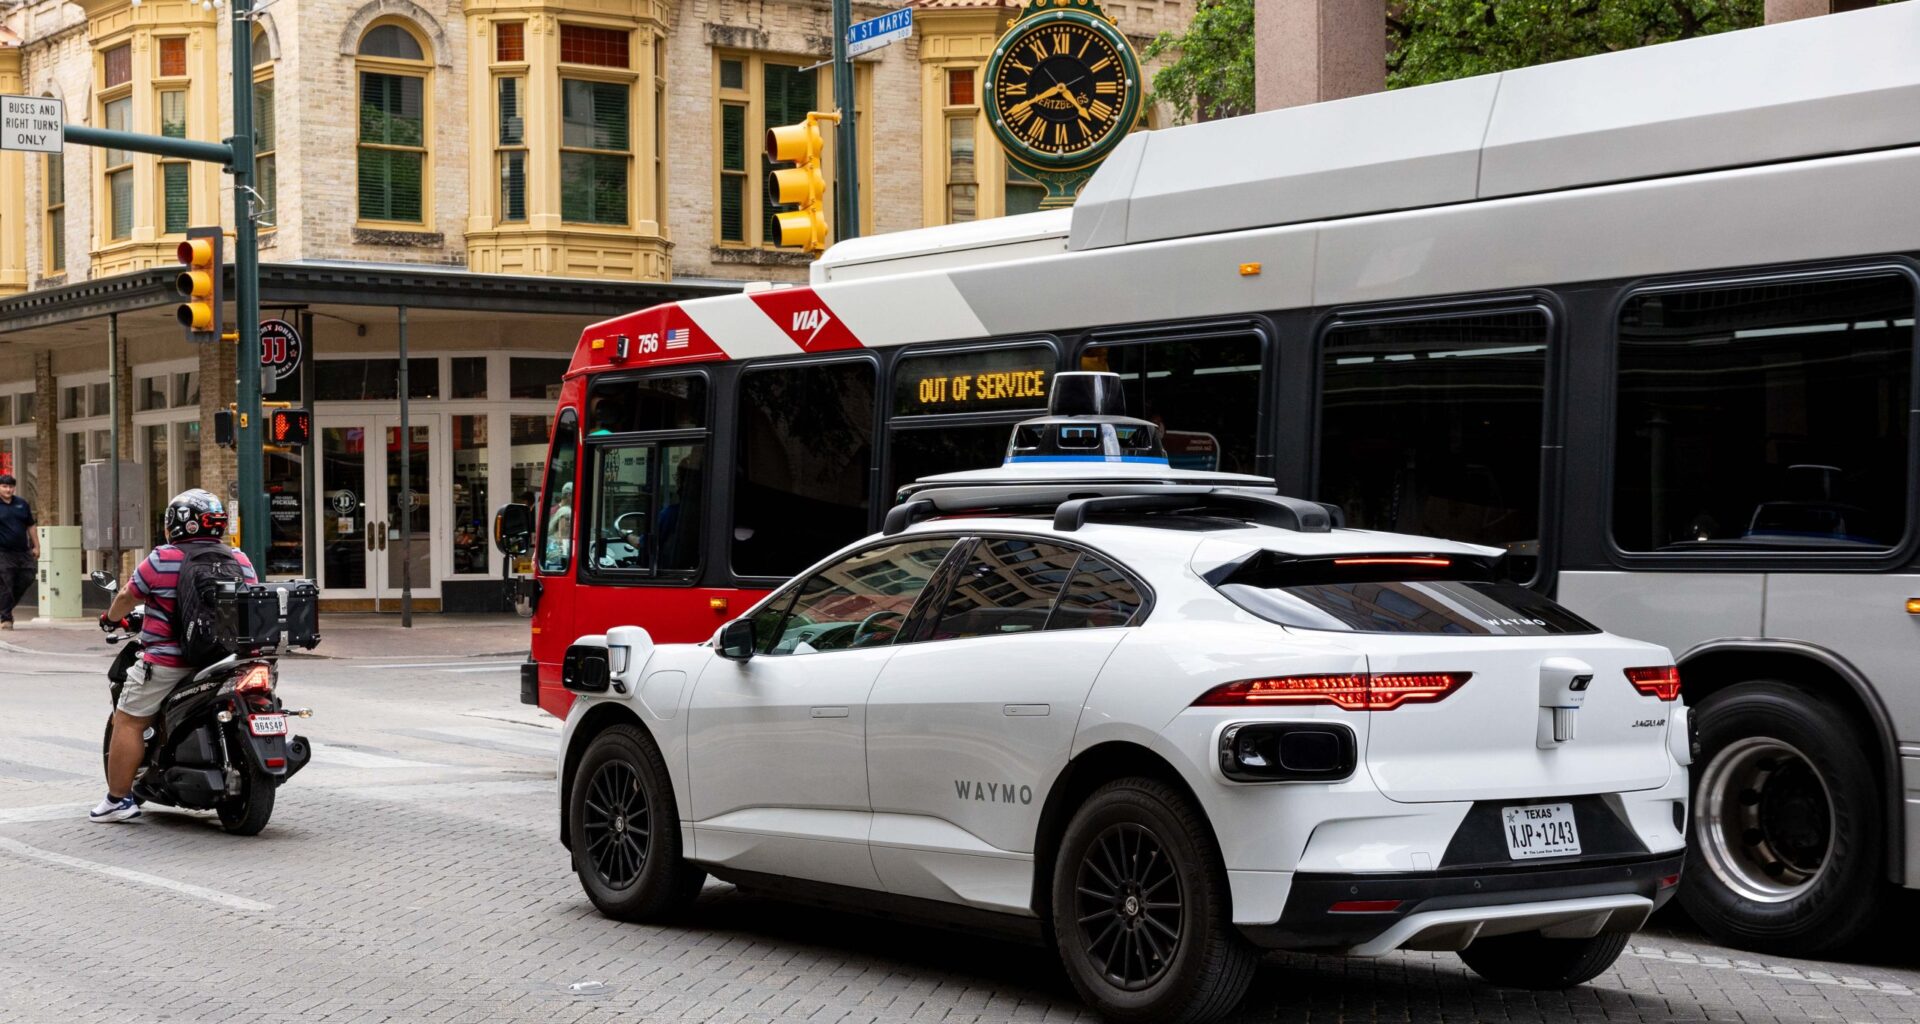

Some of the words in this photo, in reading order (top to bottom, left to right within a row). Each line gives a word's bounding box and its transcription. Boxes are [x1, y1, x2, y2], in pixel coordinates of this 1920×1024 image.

[850, 27, 856, 43] N
[861, 22, 873, 39] ST
[878, 10, 910, 33] MARYS
[1053, 33, 1070, 54] XII
[9, 102, 36, 115] BUSES
[39, 104, 56, 116] AND
[5, 117, 29, 129] RIGHT
[33, 119, 59, 132] TURNS
[17, 133, 47, 146] ONLY
[792, 309, 819, 331] VIA
[261, 337, 287, 364] JJ
[638, 333, 659, 354] 756
[919, 377, 948, 403] OUT
[952, 375, 972, 401] OF
[976, 370, 1045, 400] SERVICE
[299, 416, 308, 438] 4
[1481, 618, 1546, 626] WAYMO
[1631, 718, 1666, 728] JAGUAR
[954, 779, 1033, 806] WAYMO
[1524, 808, 1553, 820] TEXAS
